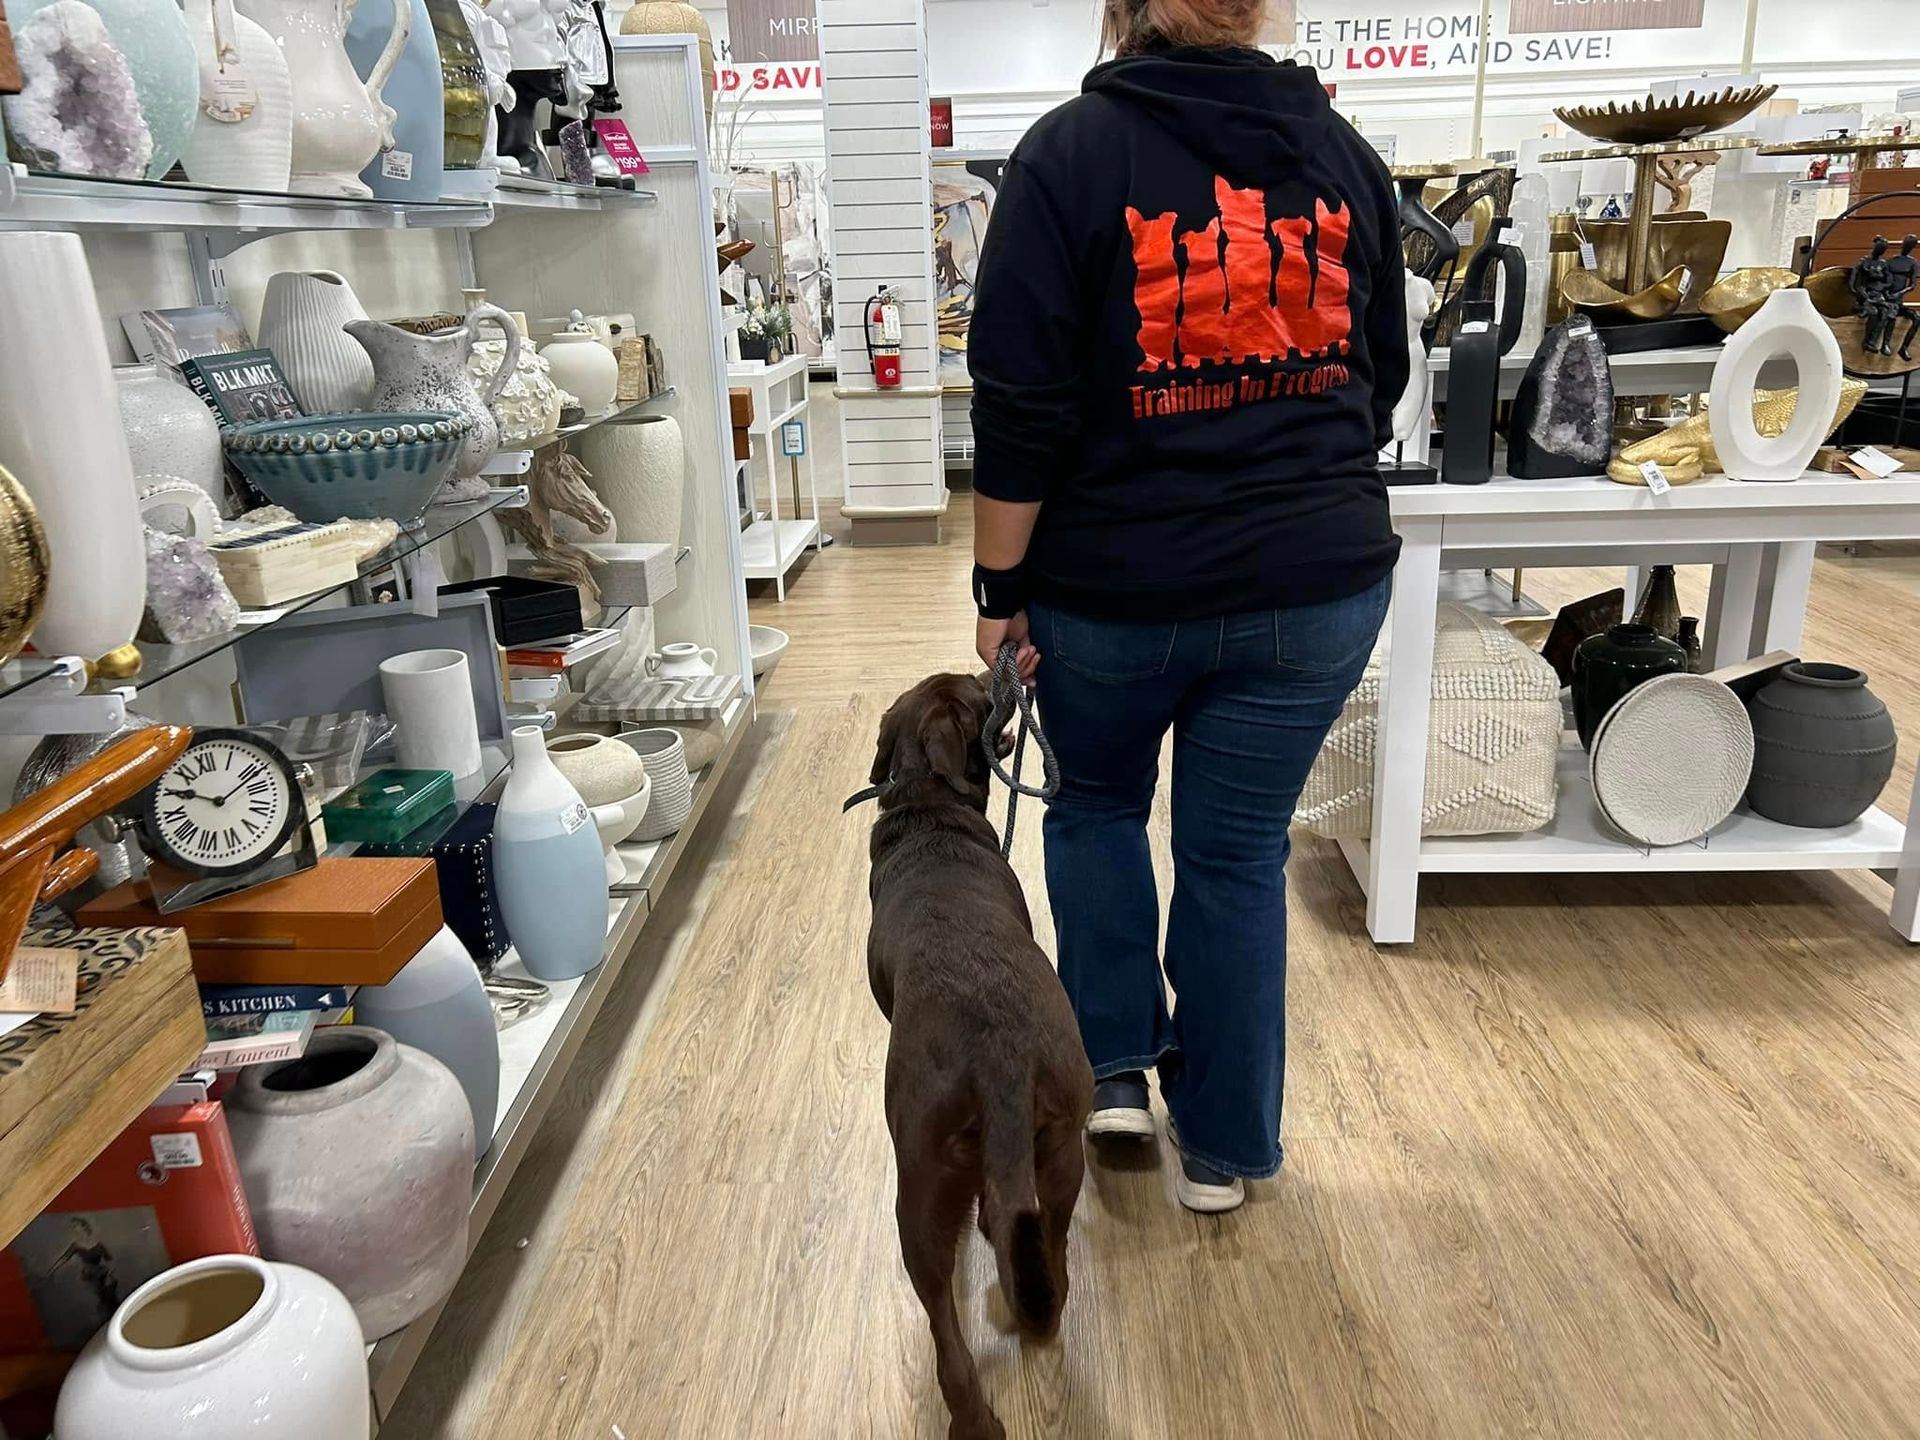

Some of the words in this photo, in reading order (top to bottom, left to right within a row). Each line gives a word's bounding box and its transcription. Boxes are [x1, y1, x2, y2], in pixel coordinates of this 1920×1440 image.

[1296, 22, 1322, 43] E
[1335, 19, 1392, 42] THE
[1405, 15, 1491, 39] HOME
[1347, 45, 1436, 70] LOVE,
[1448, 42, 1512, 64] AND
[1525, 37, 1611, 61] SAVE!
[211, 370, 246, 392] BLK
[244, 364, 278, 388] MKT
[1129, 378, 1234, 418] Training
[1240, 375, 1266, 403] In
[1270, 363, 1349, 398] Progress
[190, 376, 213, 405] BLK
[209, 405, 229, 430] MK
[219, 994, 297, 1013] KITCHEN
[224, 1046, 291, 1067] Laurent
